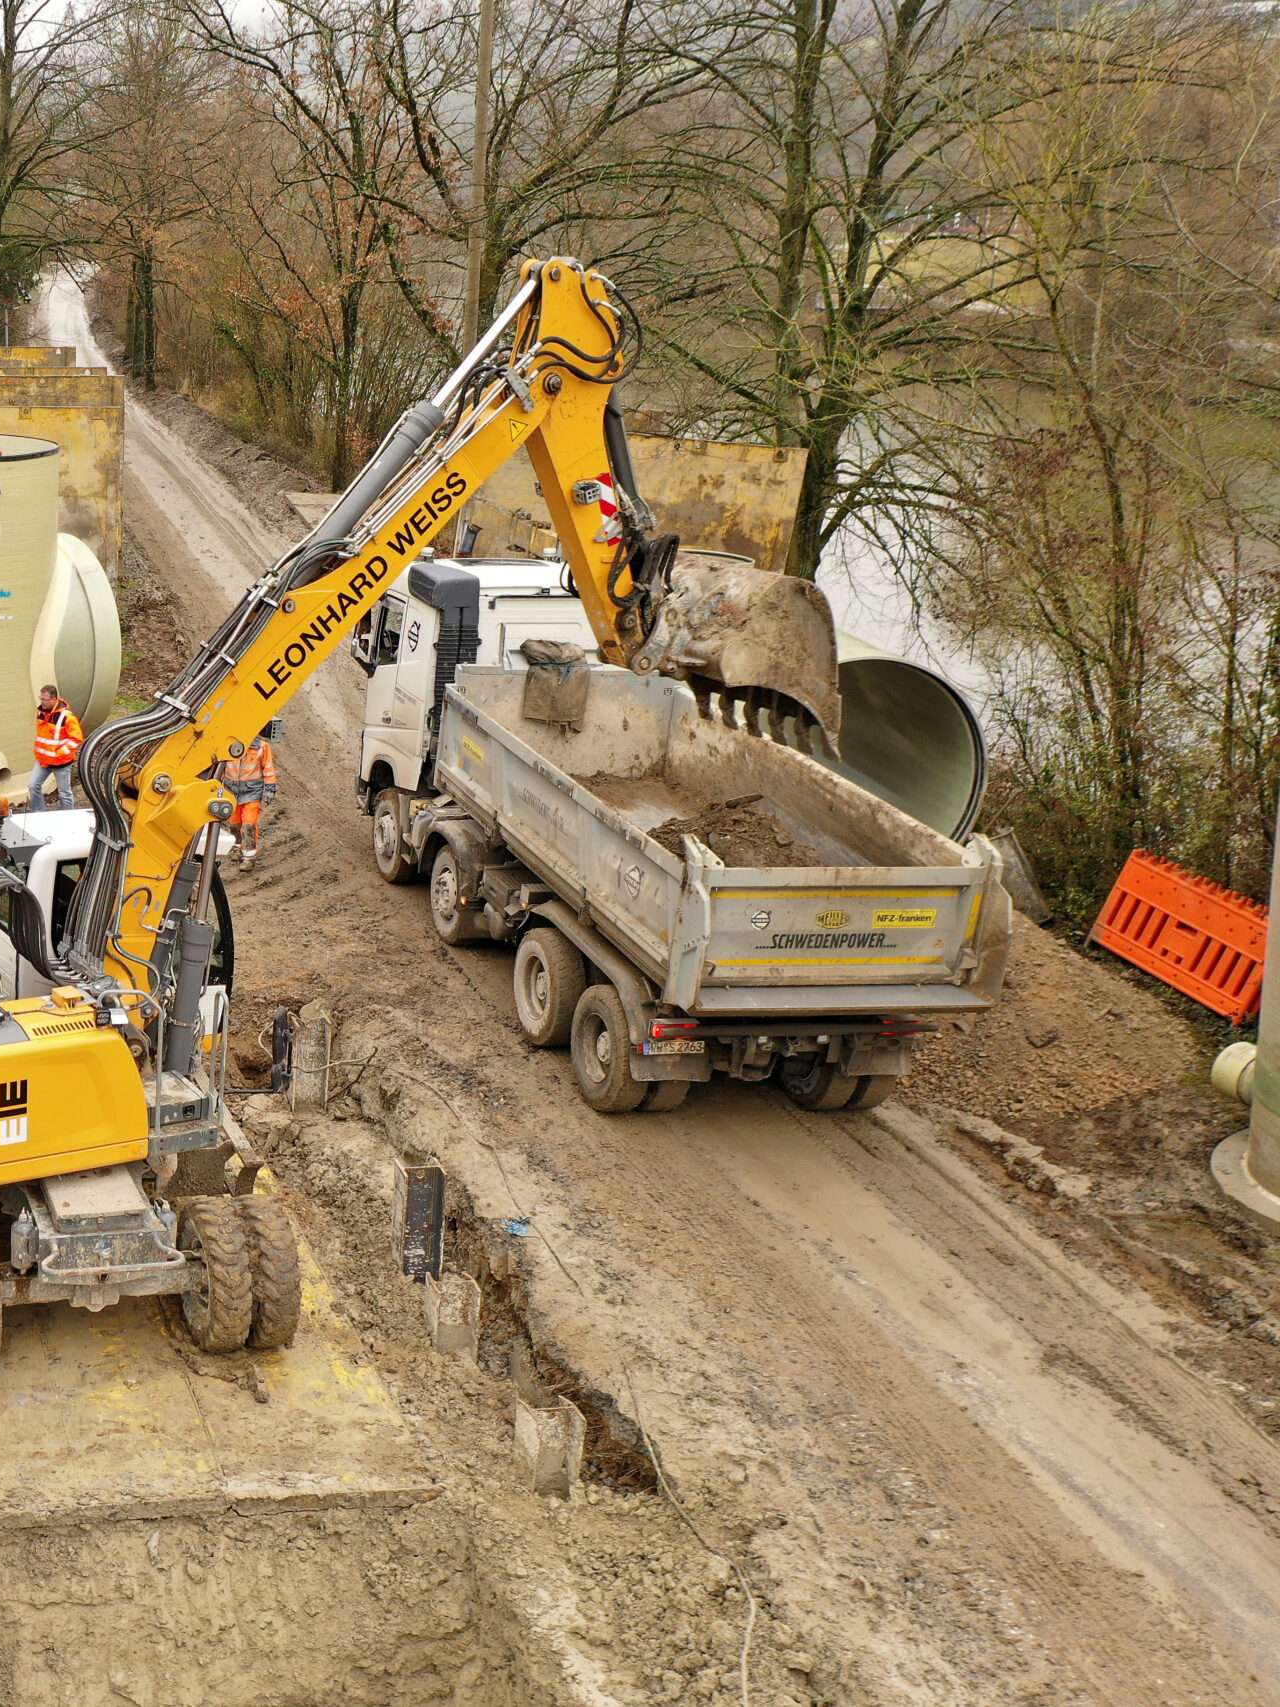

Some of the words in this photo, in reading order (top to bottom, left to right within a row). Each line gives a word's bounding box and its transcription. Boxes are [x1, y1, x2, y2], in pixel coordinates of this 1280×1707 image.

[253, 555, 390, 700] LEONHARD
[387, 471, 468, 556] WEISS
[875, 913, 933, 923] NFZ-franken
